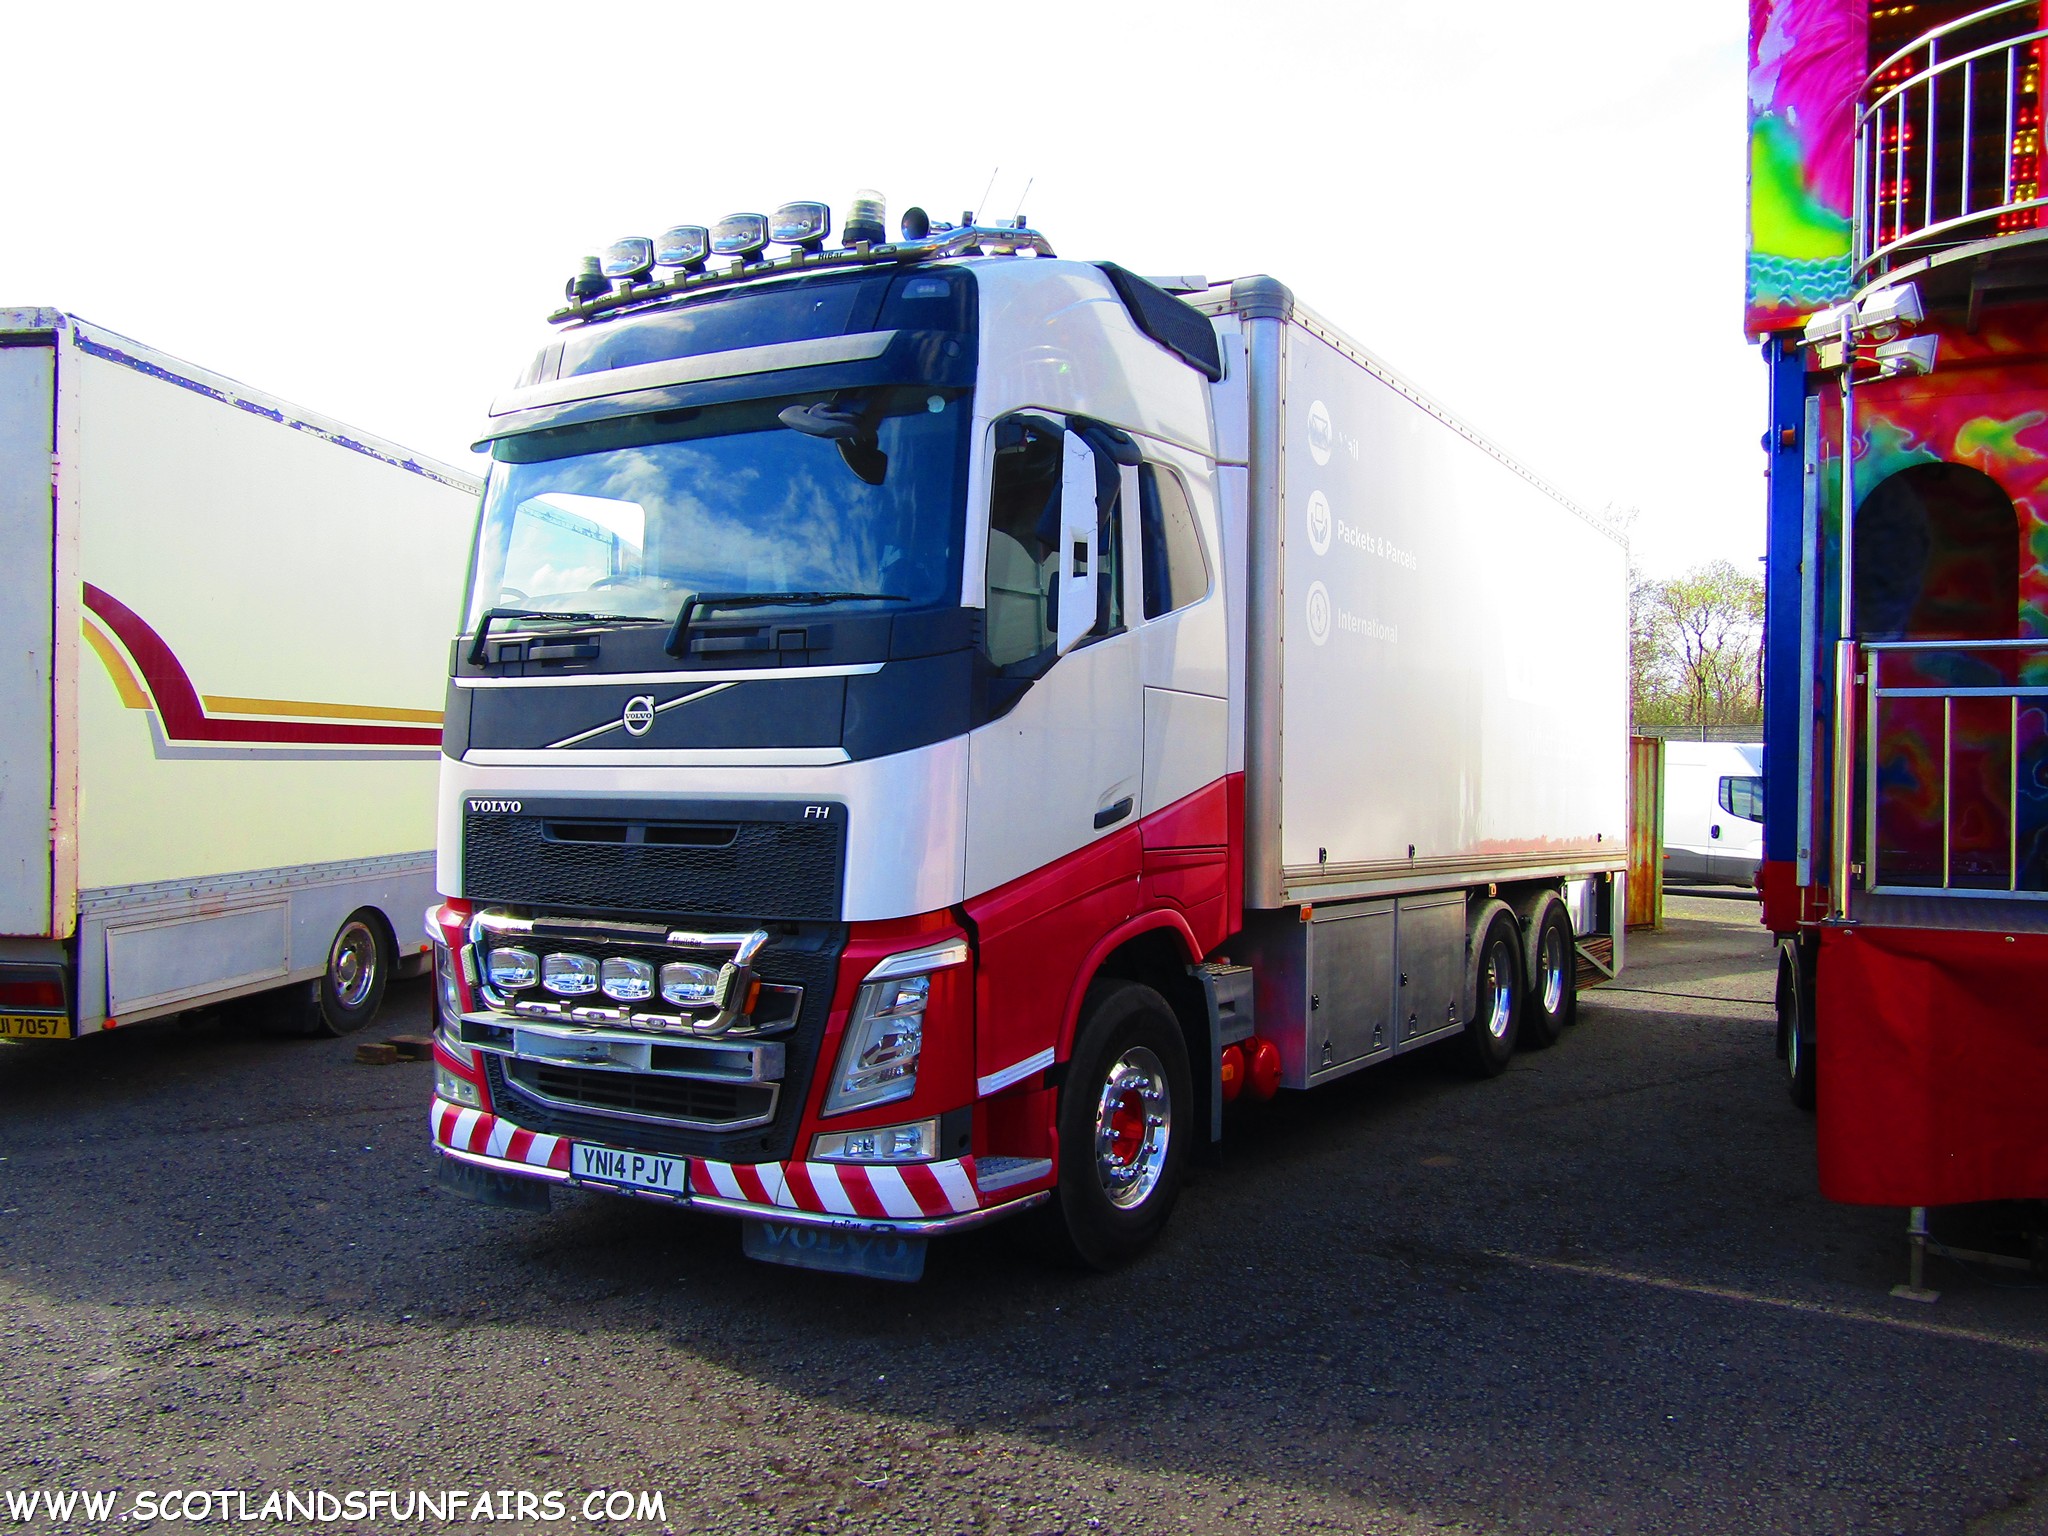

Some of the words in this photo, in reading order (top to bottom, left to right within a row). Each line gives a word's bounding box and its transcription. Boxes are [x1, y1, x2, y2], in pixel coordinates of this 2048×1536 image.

[1337, 519, 1375, 554] Packets
[1377, 536, 1385, 558] &
[1386, 540, 1417, 571] Parcels
[1338, 607, 1398, 645] International
[625, 712, 652, 720] VOLVO
[469, 800, 522, 813] VOLVO
[804, 805, 830, 819] FH
[14, 1018, 59, 1035] 7057
[583, 1148, 626, 1179] YN14
[632, 1156, 673, 1187] PJY
